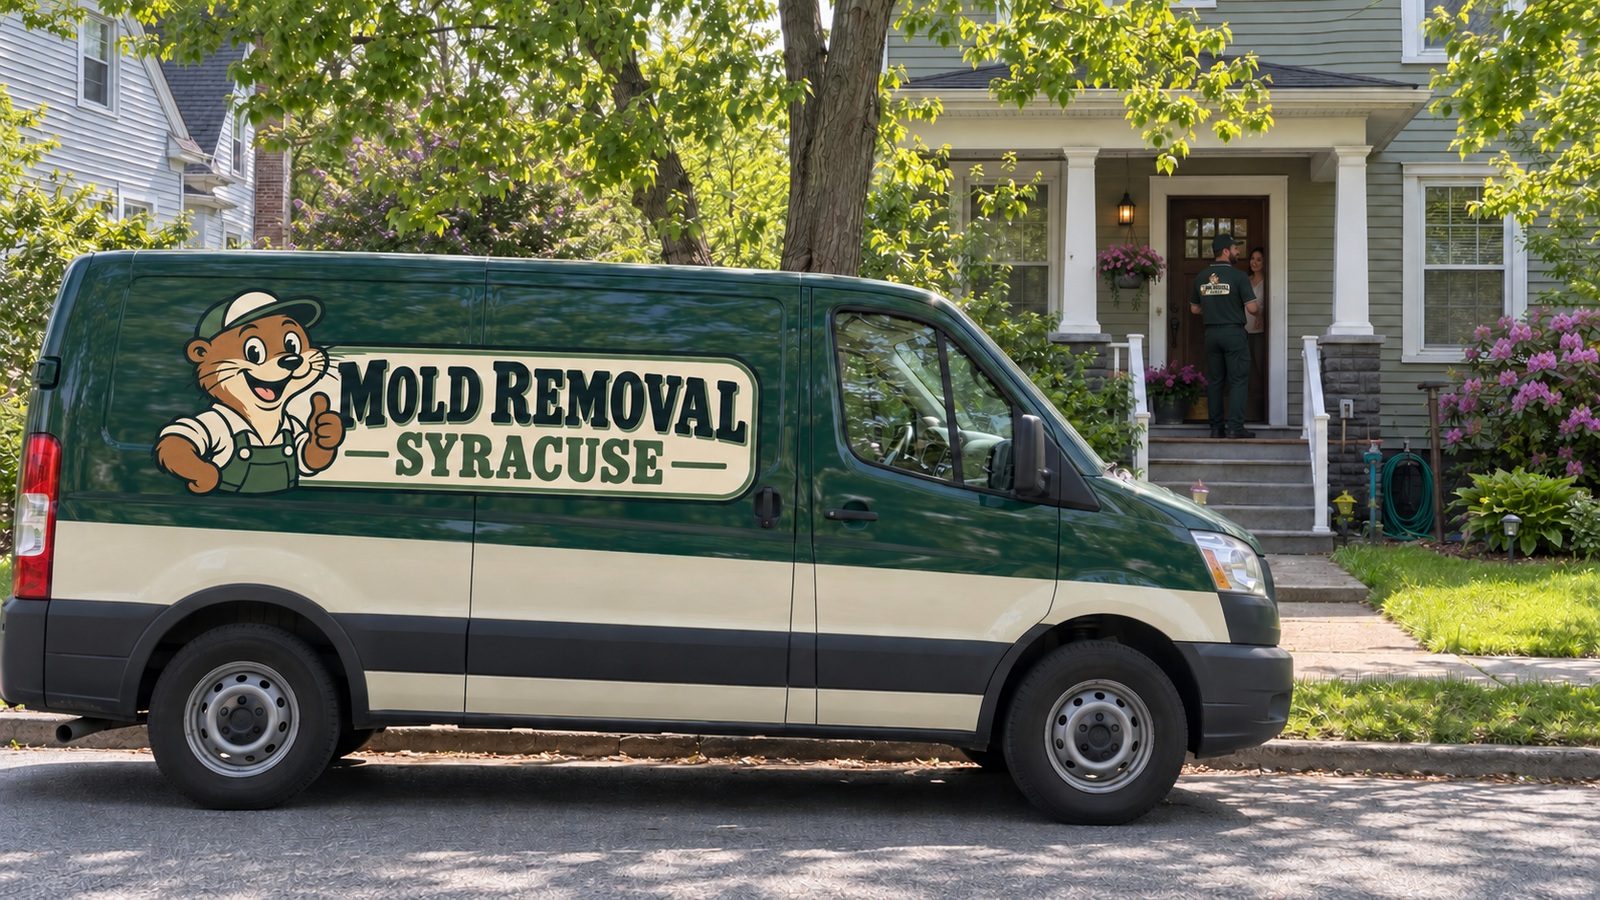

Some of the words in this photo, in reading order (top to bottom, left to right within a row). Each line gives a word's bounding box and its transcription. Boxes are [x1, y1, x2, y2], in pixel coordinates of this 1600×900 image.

[338, 359, 483, 429] MOLD
[491, 360, 748, 445] REMOVAL
[395, 431, 663, 485] SYRACUSE
